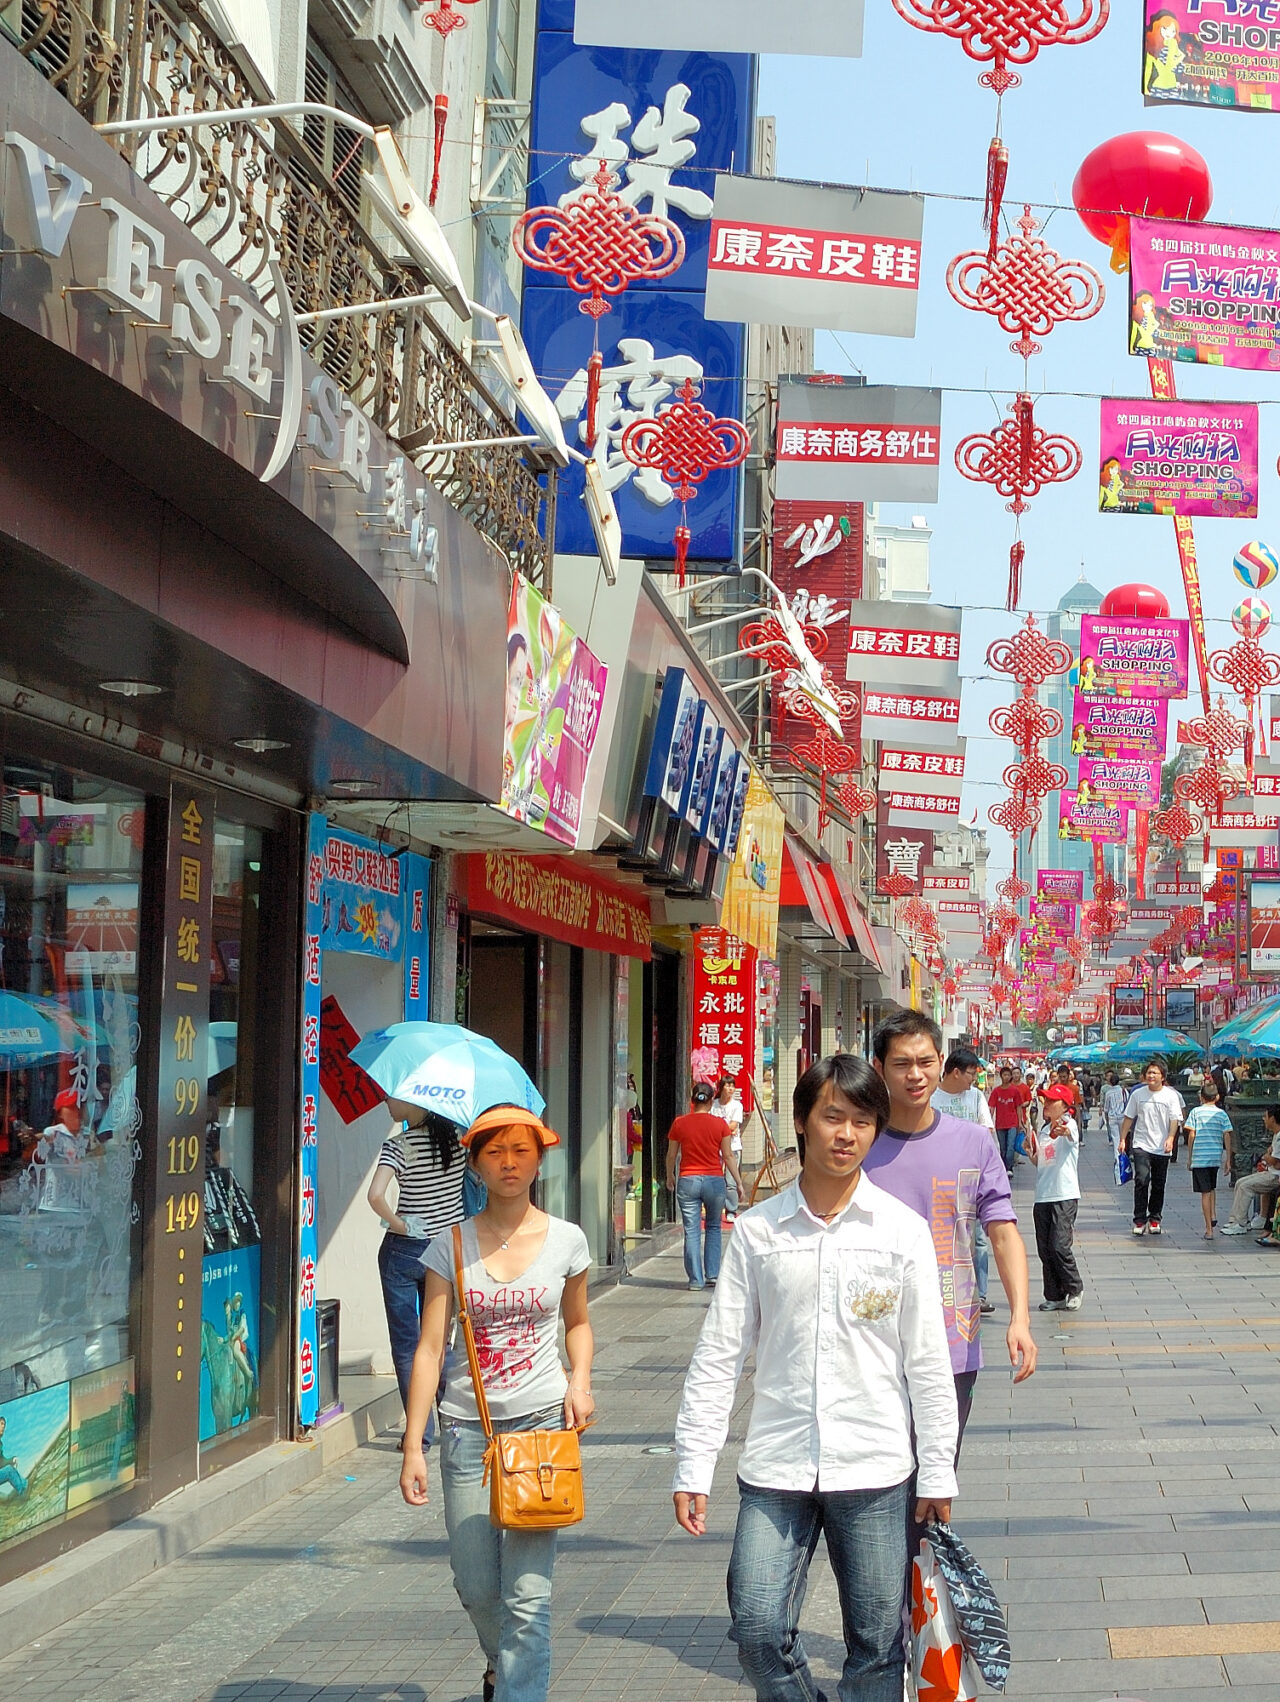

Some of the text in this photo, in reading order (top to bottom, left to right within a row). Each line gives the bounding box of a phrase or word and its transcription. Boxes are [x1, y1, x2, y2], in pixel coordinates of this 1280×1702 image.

[712, 228, 921, 284] 康奈皮鞋
[781, 427, 937, 459] 康奈商务舒仕
[1125, 428, 1241, 462] 月光购物
[1132, 462, 1234, 479] SHOPPING
[851, 629, 958, 658] 康奈皮鞋
[1097, 637, 1177, 659] 月光购物
[1102, 659, 1172, 672] SHOPPING
[865, 695, 958, 720] 康奈商务舒仕
[1091, 725, 1153, 737] SHOPPING
[882, 752, 964, 776] 康奈皮鞋
[1095, 780, 1148, 790] SHOPPING
[891, 793, 960, 813] 康奈商务舒仕
[1073, 818, 1118, 827] SHOPPING
[174, 798, 202, 1061] 全国统一价
[174, 1078, 200, 1116] 99
[412, 1083, 467, 1101] MOTO
[300, 851, 324, 1394] 舒适轻柔为特色
[167, 1135, 200, 1174] 119
[166, 1191, 200, 1233] 149
[932, 1177, 957, 1266] AIRPORT
[464, 1286, 549, 1316] BARK
